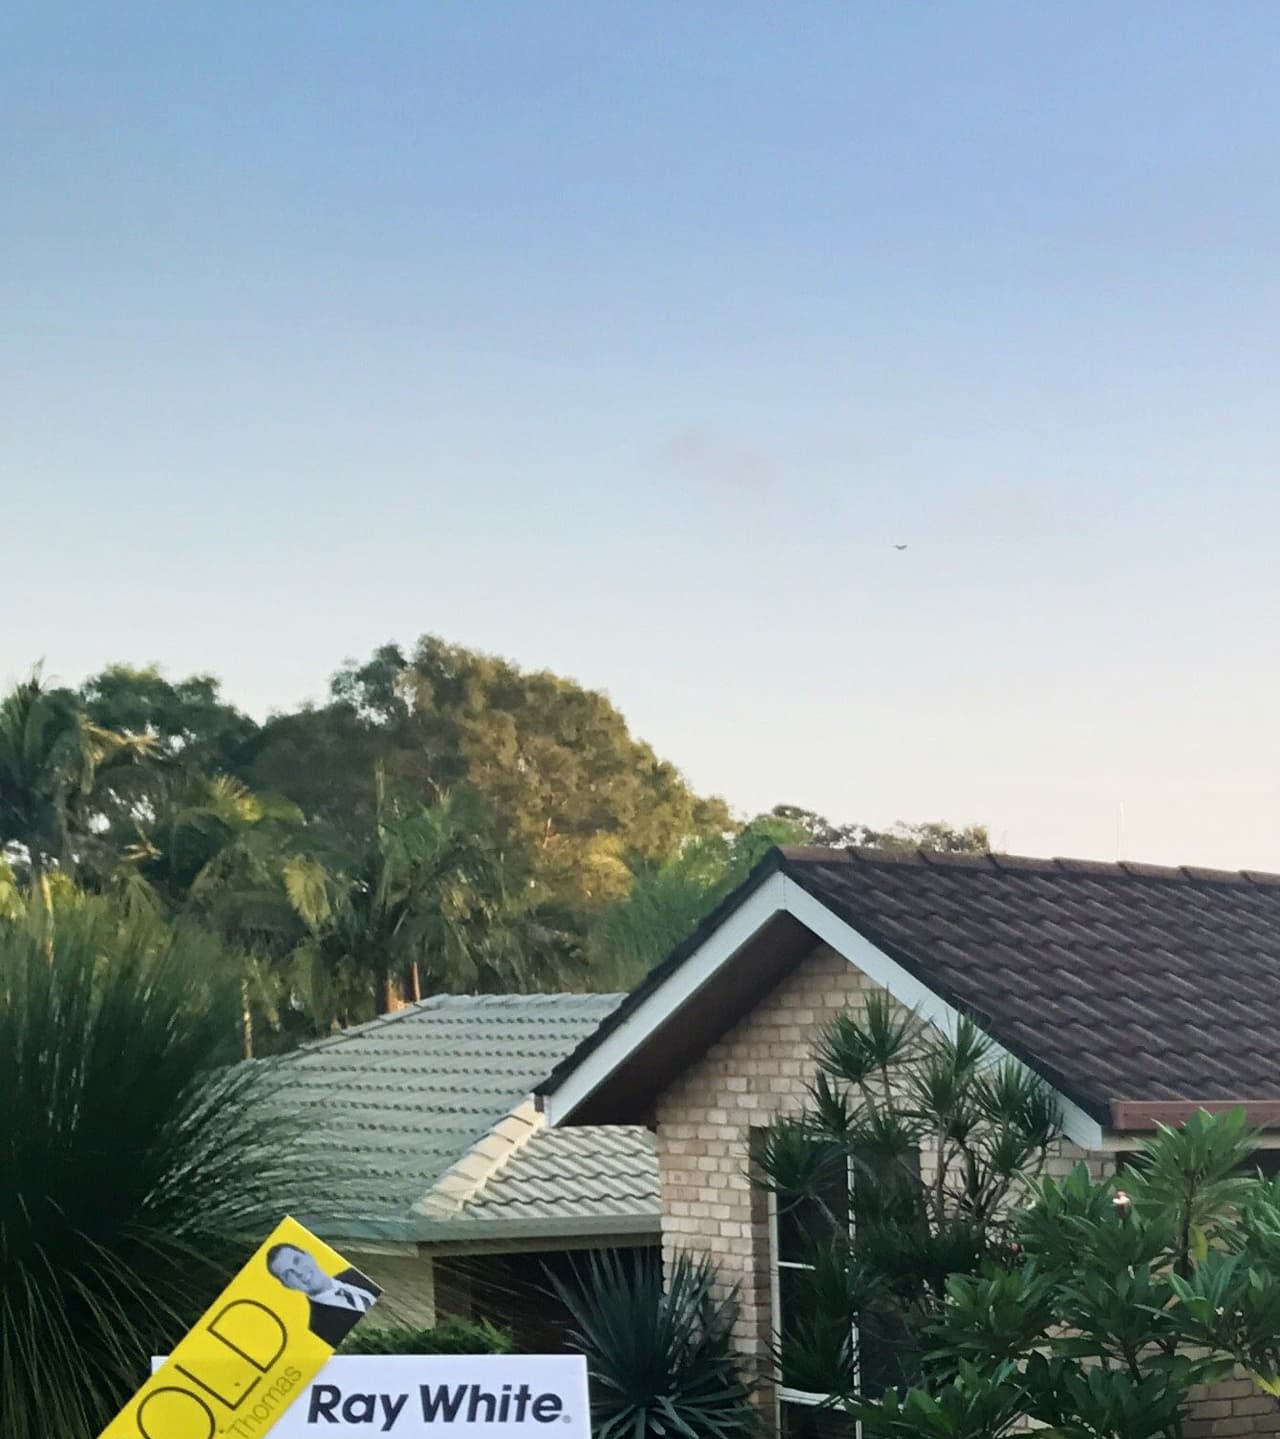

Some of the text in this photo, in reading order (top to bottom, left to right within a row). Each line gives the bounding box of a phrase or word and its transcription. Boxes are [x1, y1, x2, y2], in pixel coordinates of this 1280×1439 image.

[226, 1366, 302, 1439] Thomas
[307, 1384, 563, 1432] Ray White
